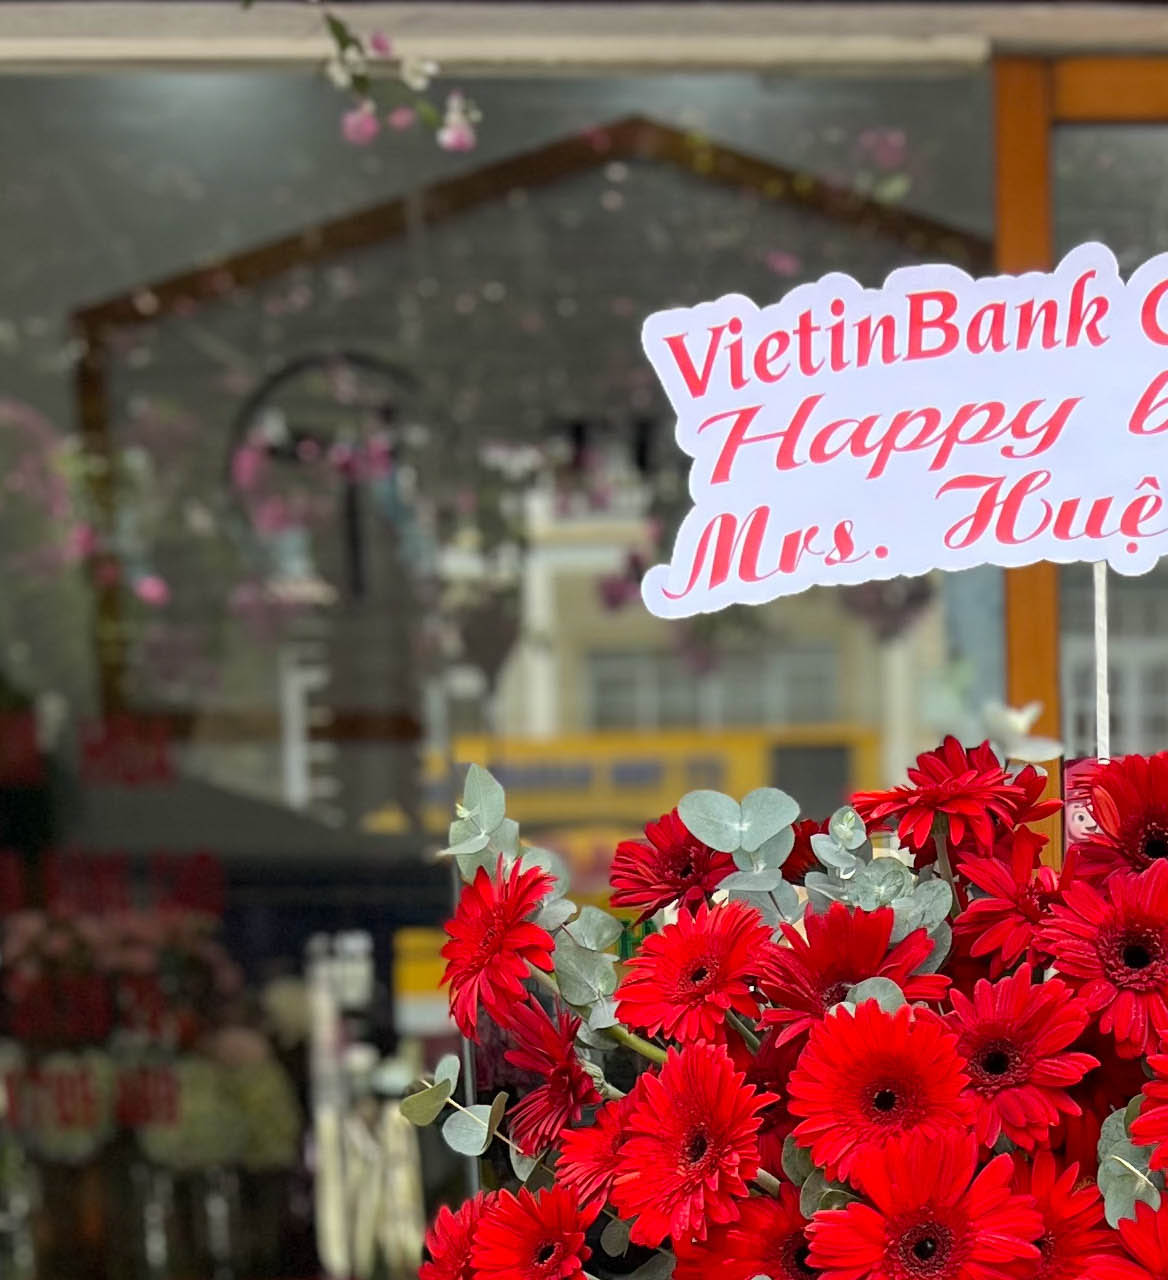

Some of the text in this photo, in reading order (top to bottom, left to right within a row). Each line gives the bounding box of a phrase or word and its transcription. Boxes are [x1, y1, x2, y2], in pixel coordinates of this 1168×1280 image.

[663, 268, 1110, 400] VietinBank
[695, 393, 1084, 487] Happy
[661, 503, 890, 601] Mrs.
[935, 469, 1168, 556] Huệ
